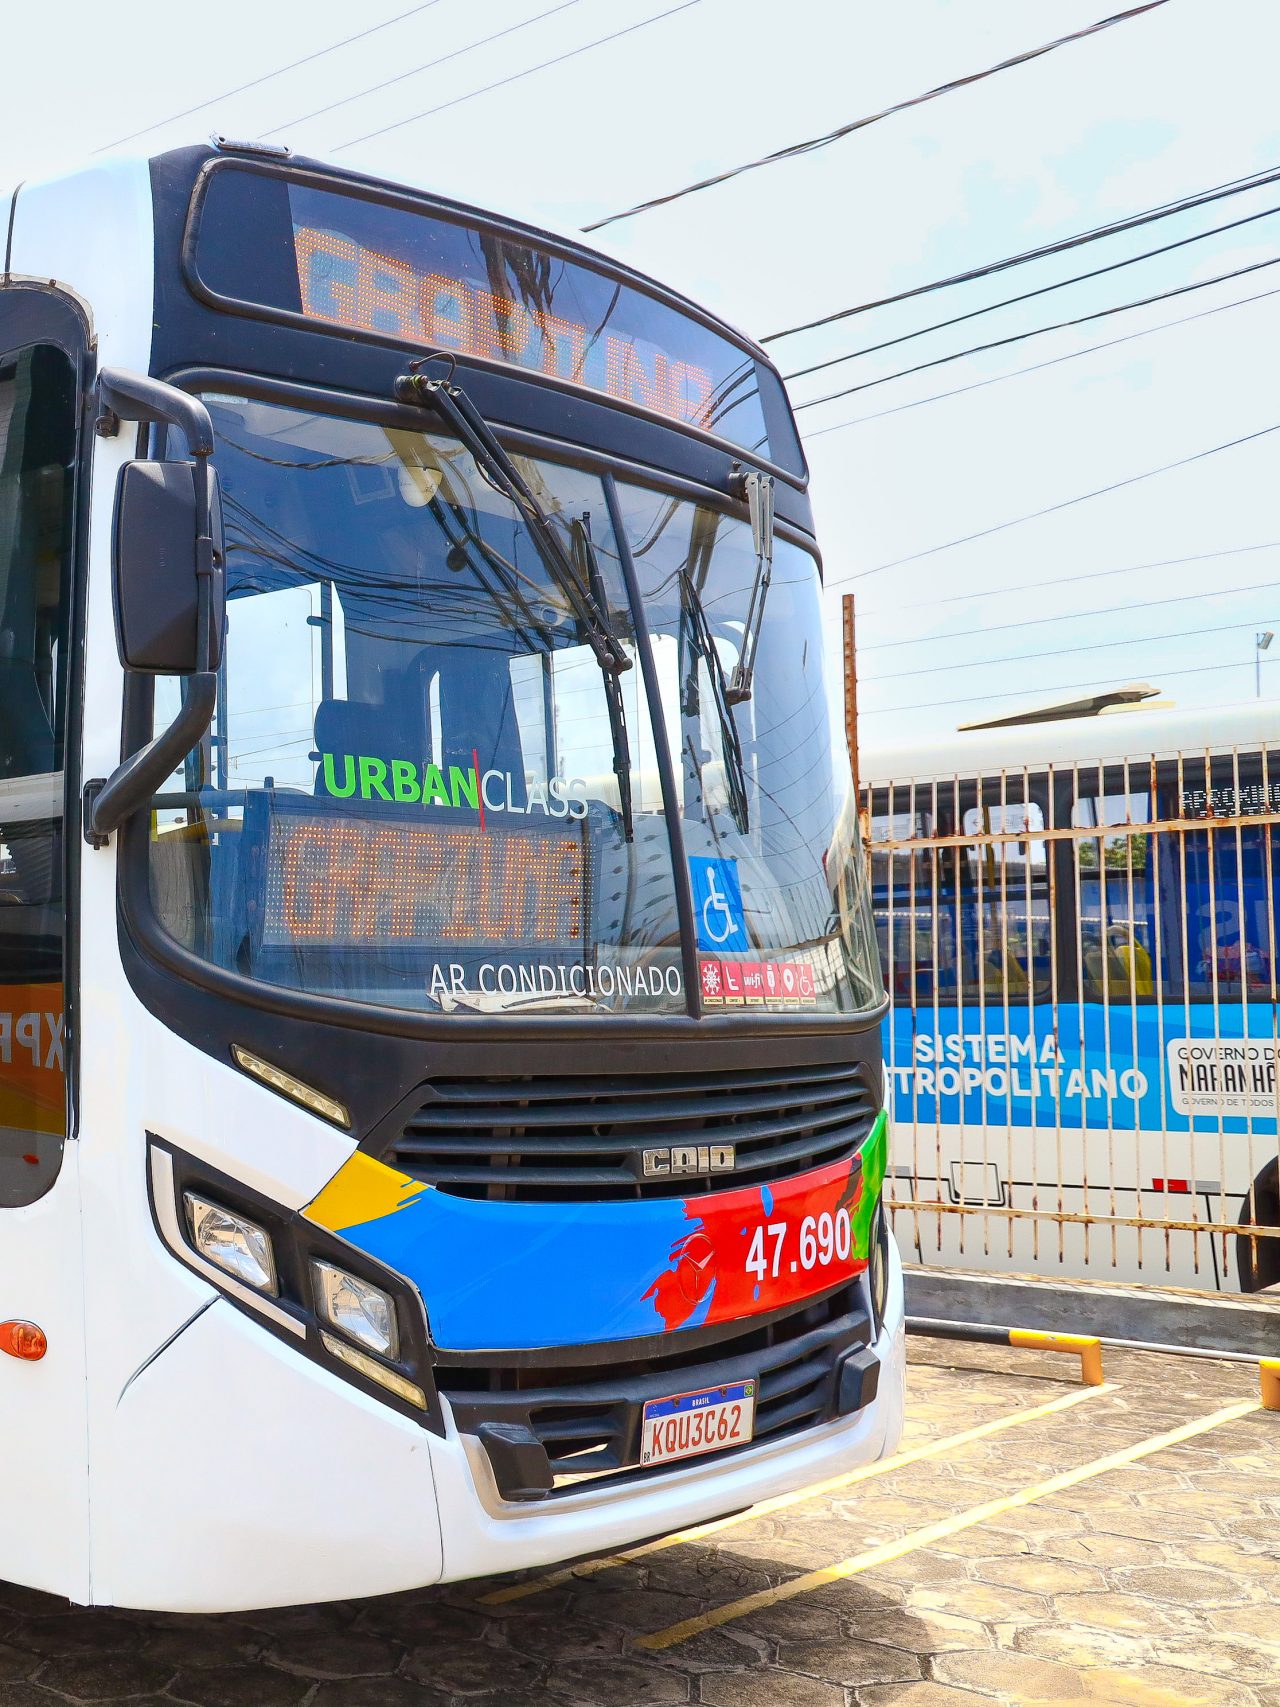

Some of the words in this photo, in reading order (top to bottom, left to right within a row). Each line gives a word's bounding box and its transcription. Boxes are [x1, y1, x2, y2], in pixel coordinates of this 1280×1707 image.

[323, 753, 480, 809] URBAN
[481, 769, 589, 819] CLASS
[430, 963, 471, 996] AR
[477, 964, 682, 997] CONDICIONADO
[914, 1033, 1066, 1065] SISTEMA
[888, 1066, 1150, 1101] TROPOLITANO
[1226, 1098, 1239, 1107] DE
[642, 1144, 736, 1178] CAIO
[745, 1207, 852, 1282] 47.690
[691, 1396, 710, 1408] BRASIL
[651, 1404, 743, 1458] KQU3C62
